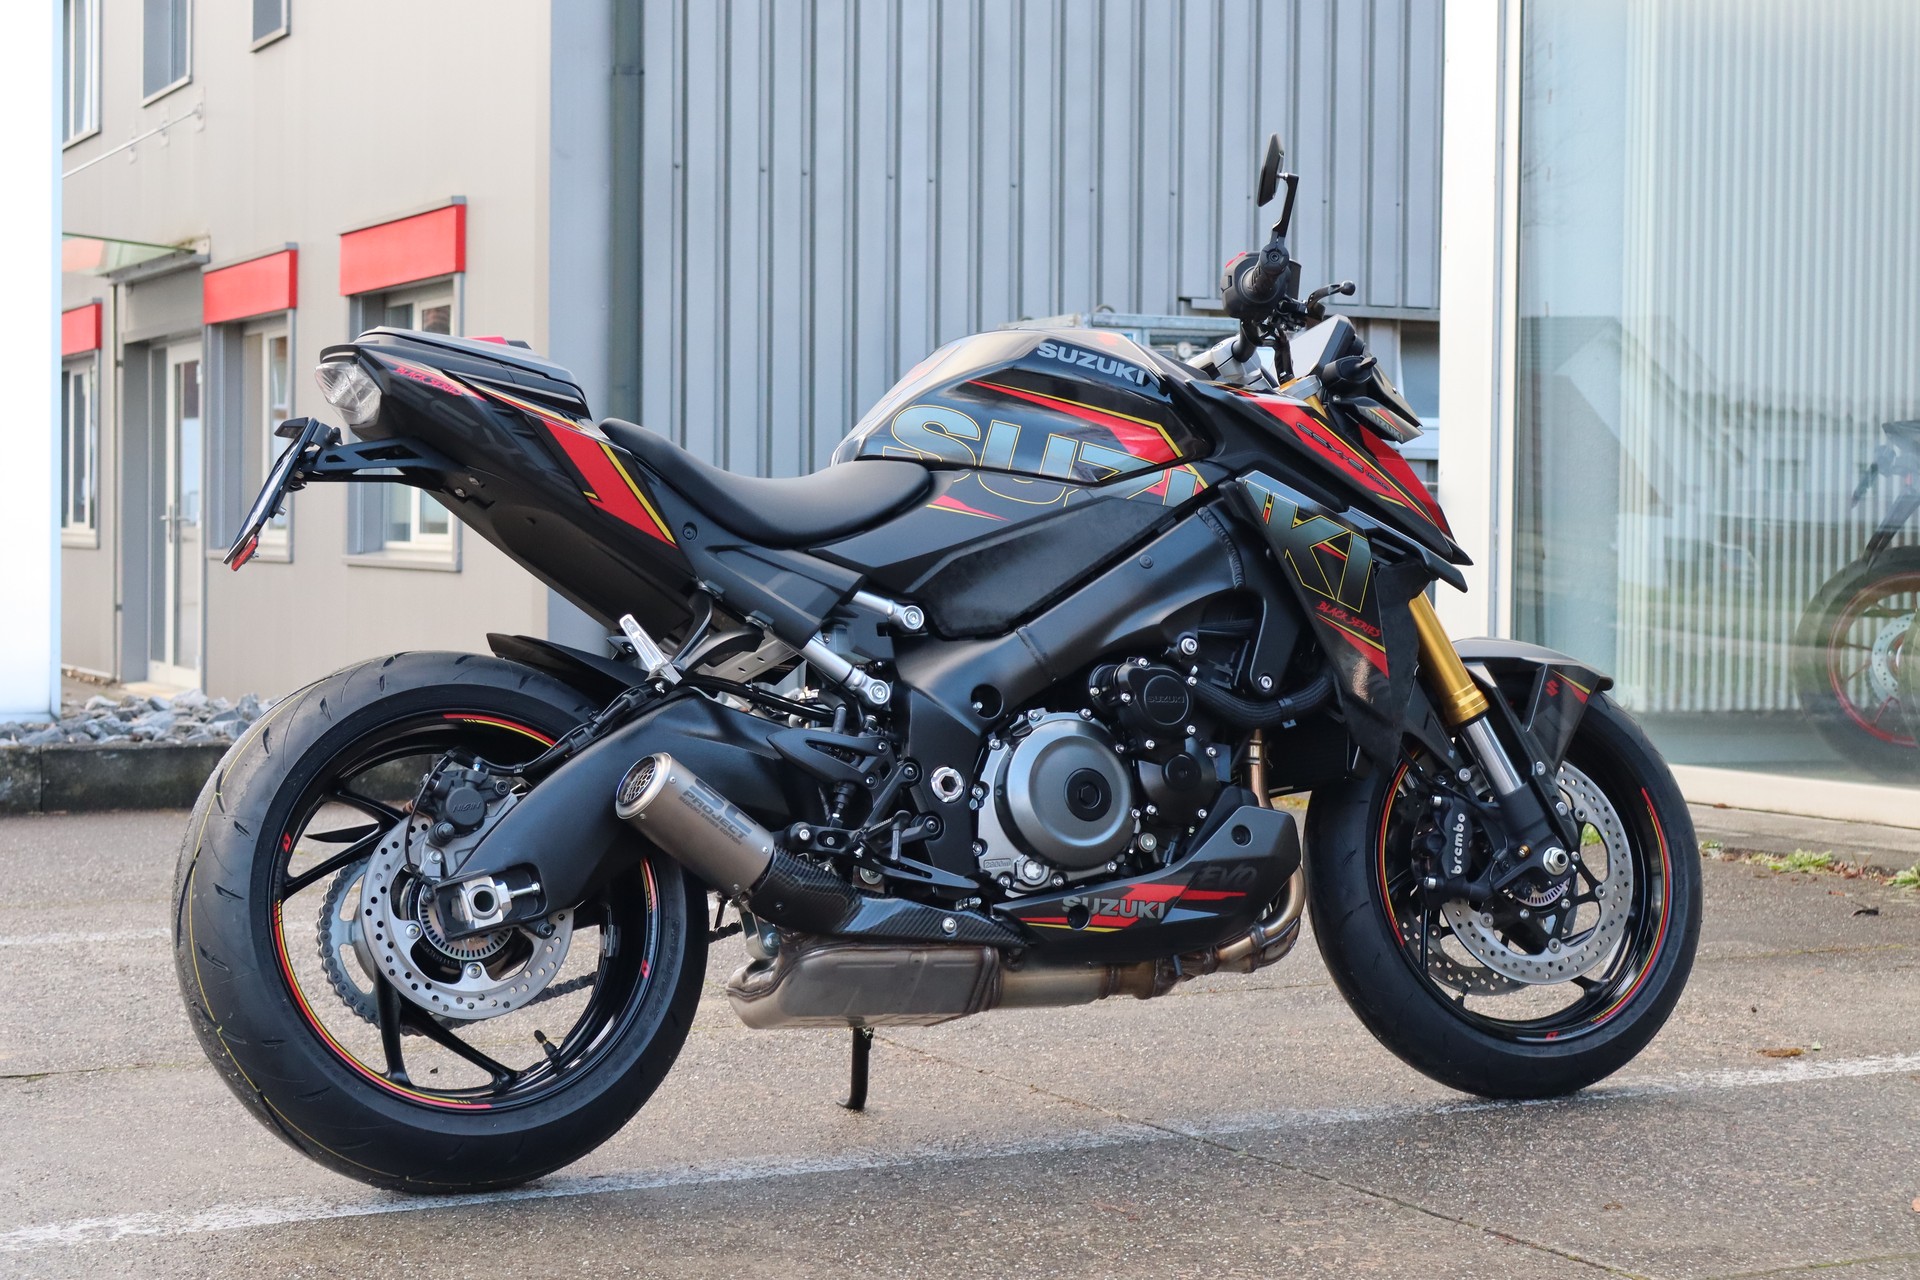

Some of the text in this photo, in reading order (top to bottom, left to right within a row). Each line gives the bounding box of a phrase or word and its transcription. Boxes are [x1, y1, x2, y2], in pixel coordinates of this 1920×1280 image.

[394, 366, 426, 383] BLACK
[1037, 342, 1146, 385] SUZUKI
[1316, 601, 1381, 637] BLACK SERIES
[1147, 696, 1185, 704] SUZUKI
[682, 790, 748, 838] PROJECT
[1451, 813, 1466, 874] brembo
[1062, 896, 1165, 919] SUZUKI
